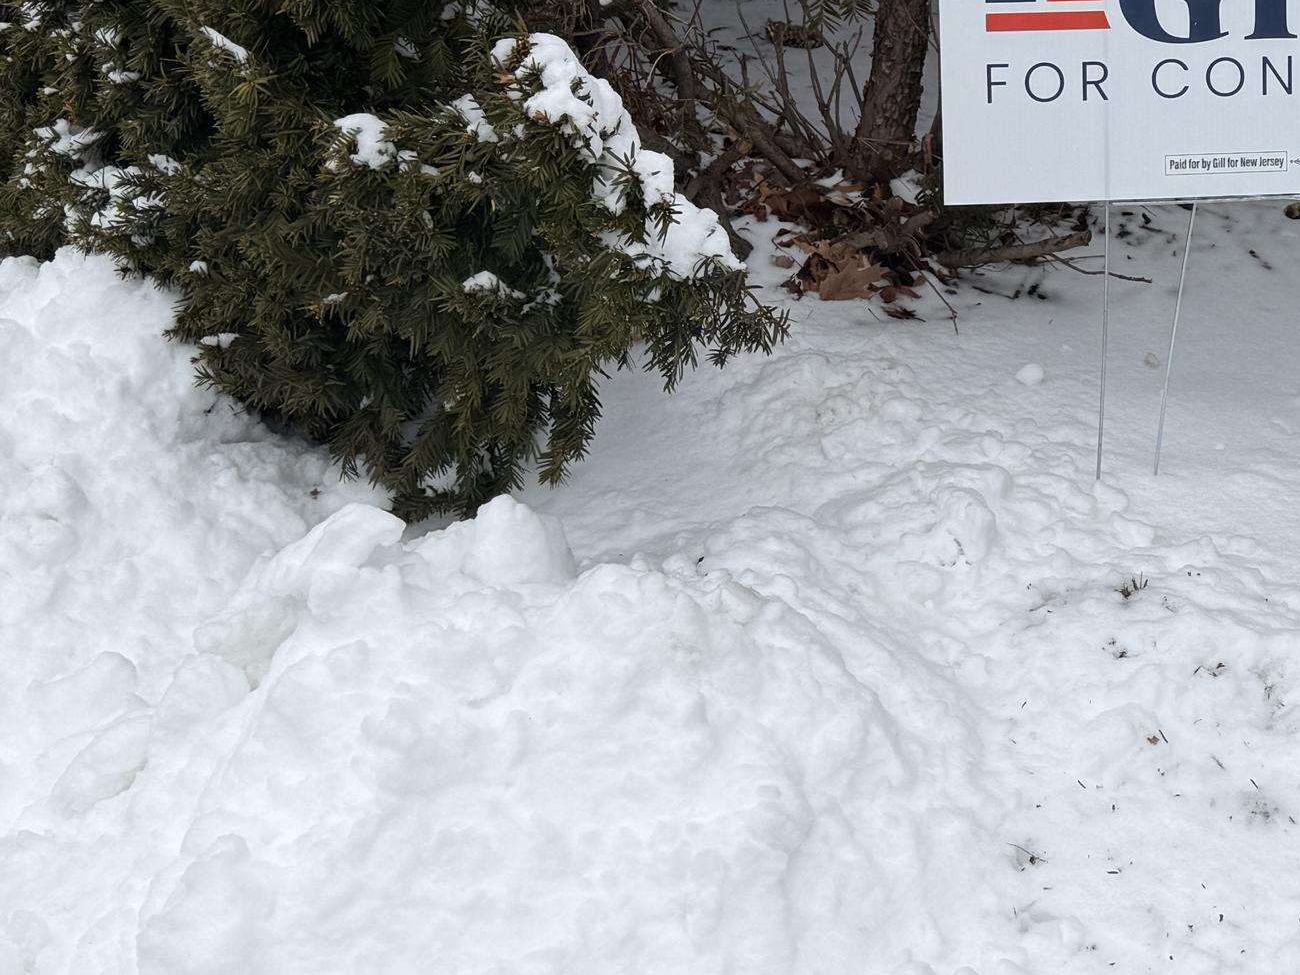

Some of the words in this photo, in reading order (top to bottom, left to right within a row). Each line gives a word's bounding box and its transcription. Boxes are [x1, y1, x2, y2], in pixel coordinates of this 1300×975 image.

[986, 61, 1109, 104] FOR
[1169, 159, 1187, 170] Paid
[1188, 158, 1200, 169] for
[1201, 158, 1211, 171] by
[1212, 157, 1226, 169] Gill
[1227, 157, 1239, 168] for
[1240, 157, 1258, 167] New
[1259, 156, 1284, 169] Jersey
